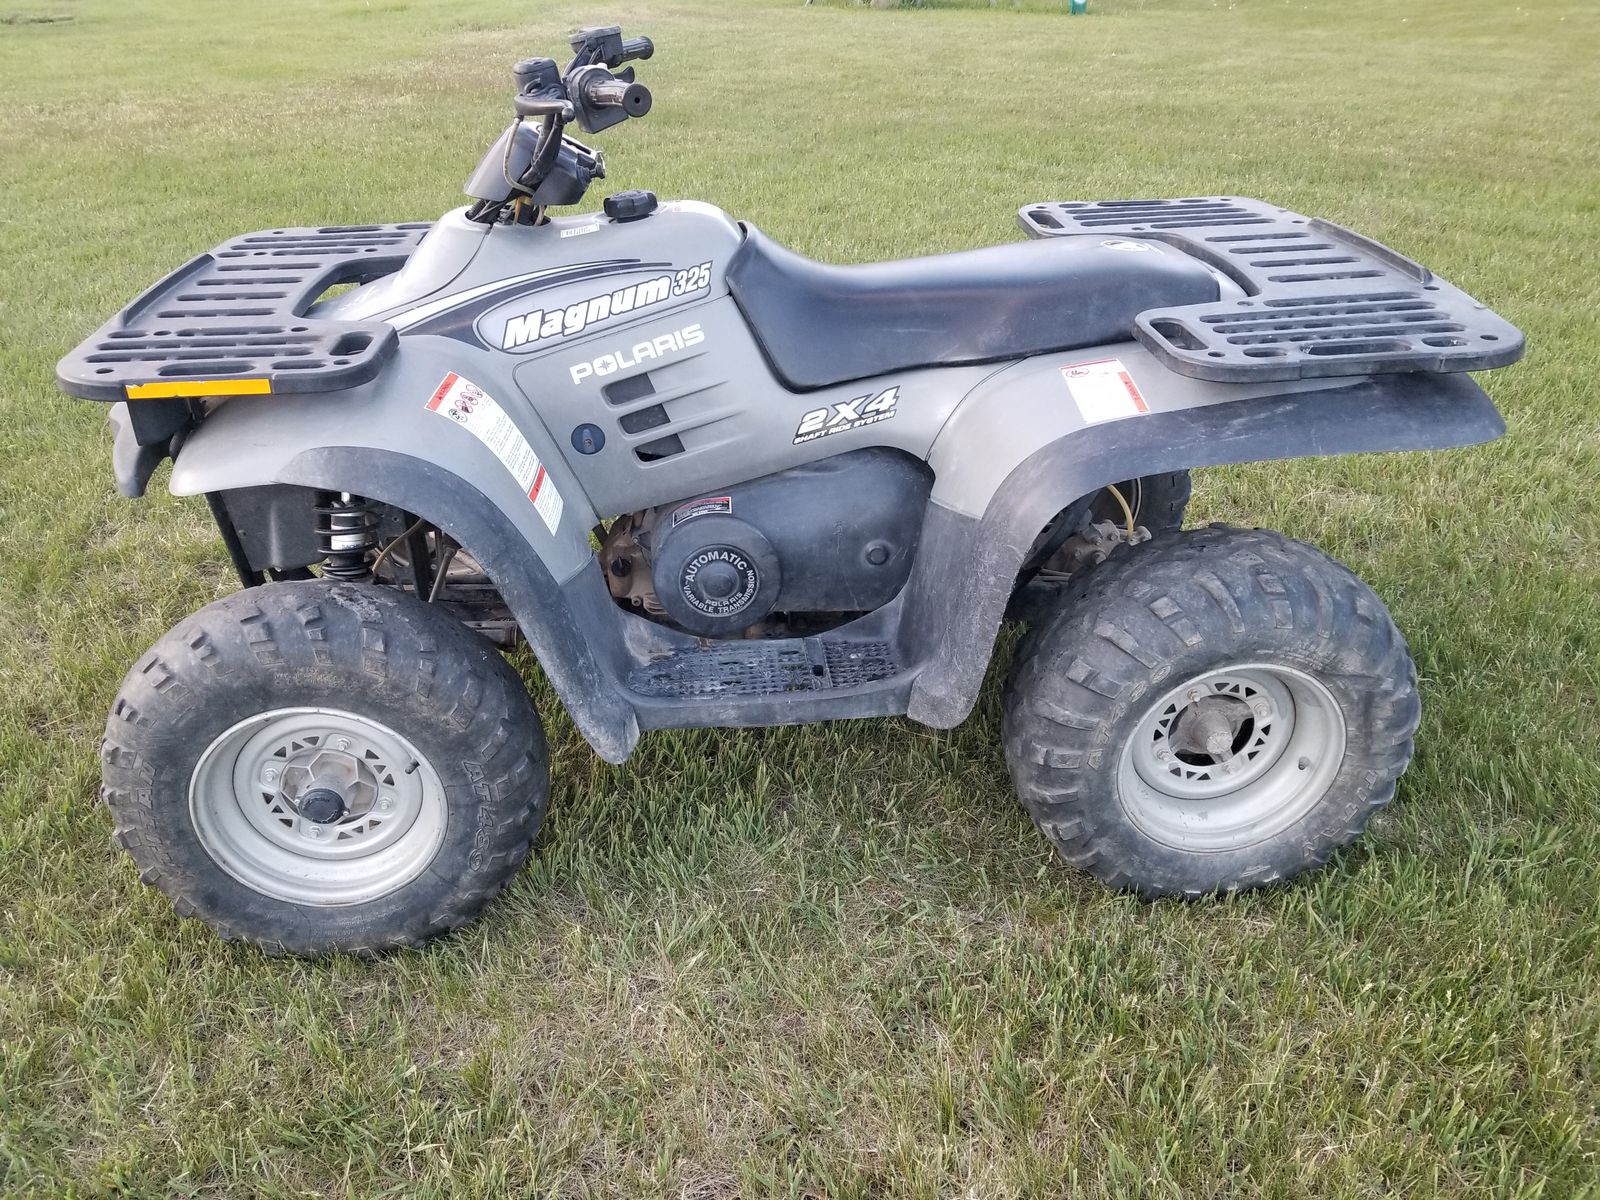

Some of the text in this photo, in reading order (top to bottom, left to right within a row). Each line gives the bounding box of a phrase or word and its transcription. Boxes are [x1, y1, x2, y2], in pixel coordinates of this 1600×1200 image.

[502, 260, 713, 349] Magnum 325
[569, 323, 705, 385] POLARIS
[793, 409, 896, 445] SHAFT RIDE SYSTEM
[796, 385, 900, 436] 2X4
[685, 550, 748, 582] AUTOMATIC
[683, 569, 755, 613] VARIABLE TRANSMISSION
[705, 591, 743, 607] POLARIS
